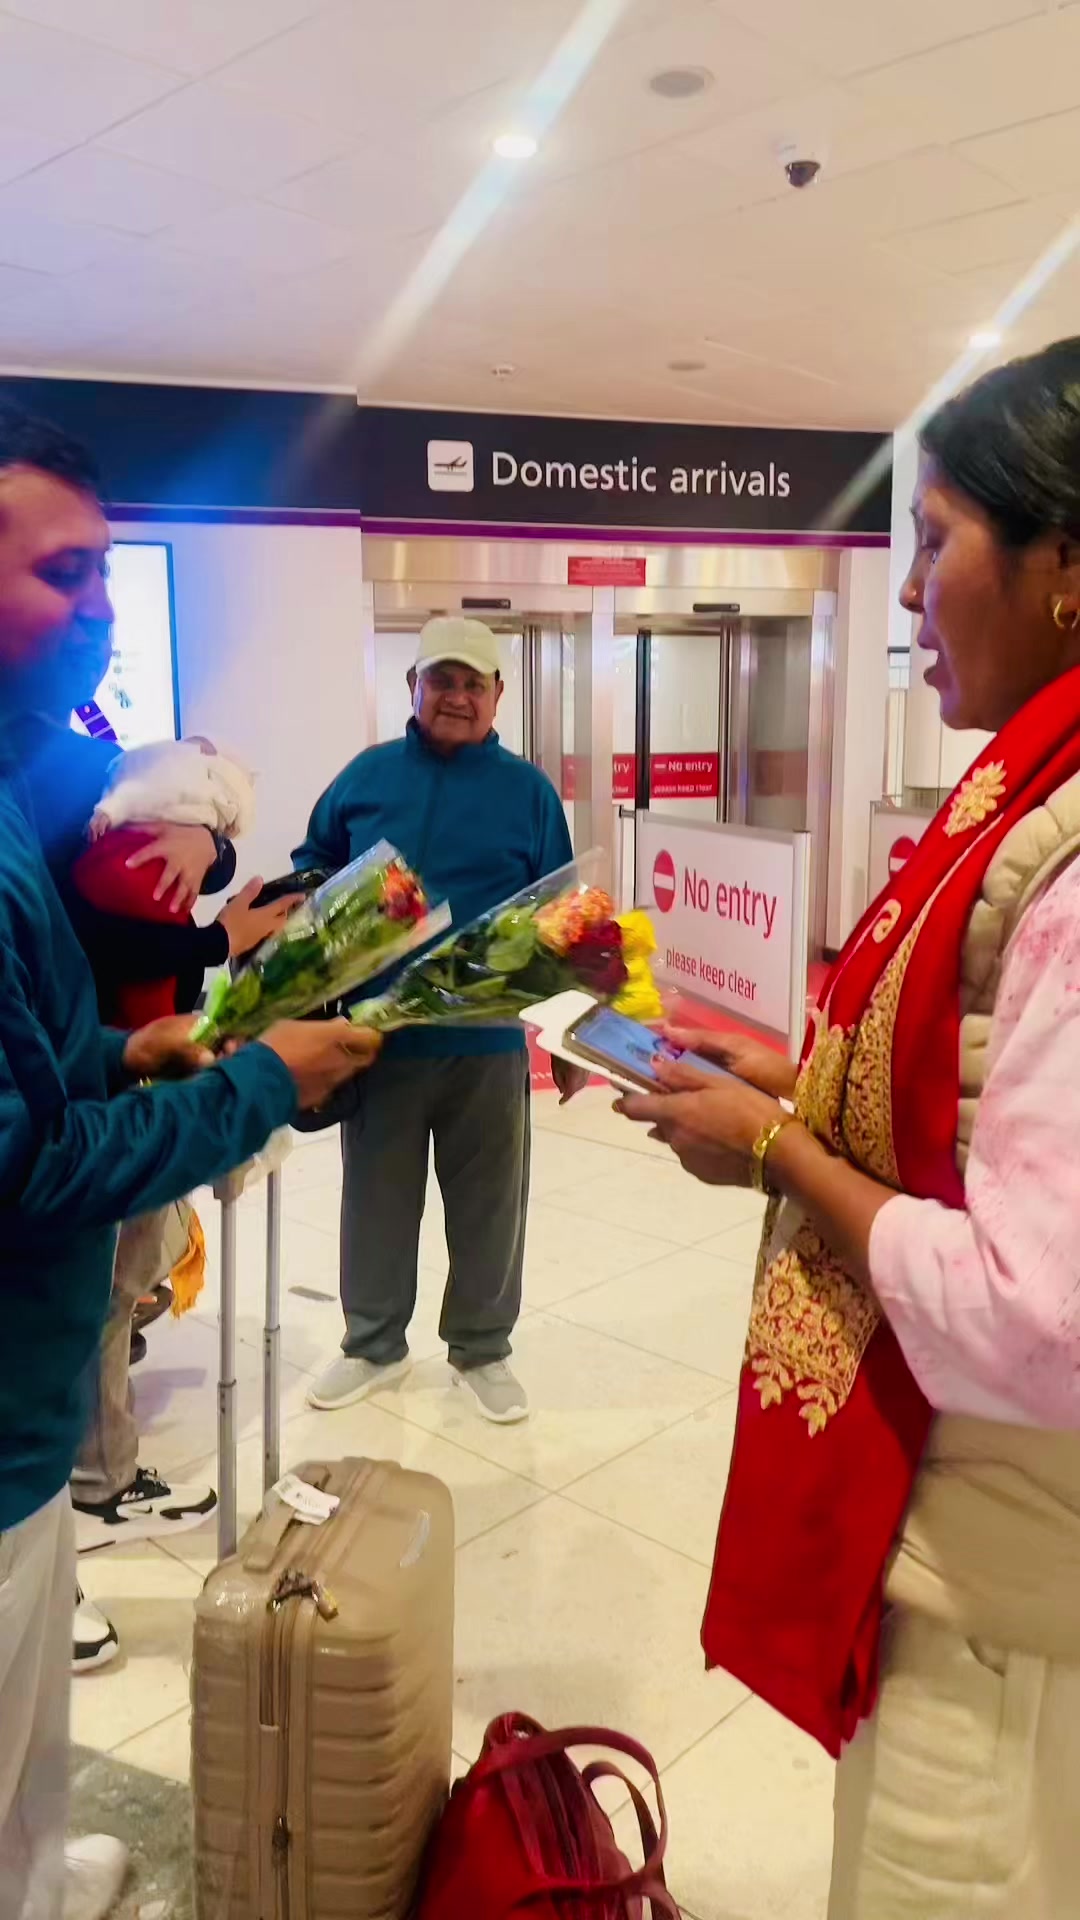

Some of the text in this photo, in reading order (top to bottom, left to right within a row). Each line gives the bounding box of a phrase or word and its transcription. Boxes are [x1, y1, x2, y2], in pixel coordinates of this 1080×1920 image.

[492, 451, 791, 498] Domestic arrivals
[614, 761, 630, 774] try
[668, 760, 713, 773] No entry
[684, 866, 777, 939] No entry
[666, 946, 757, 1001] please keep clear
